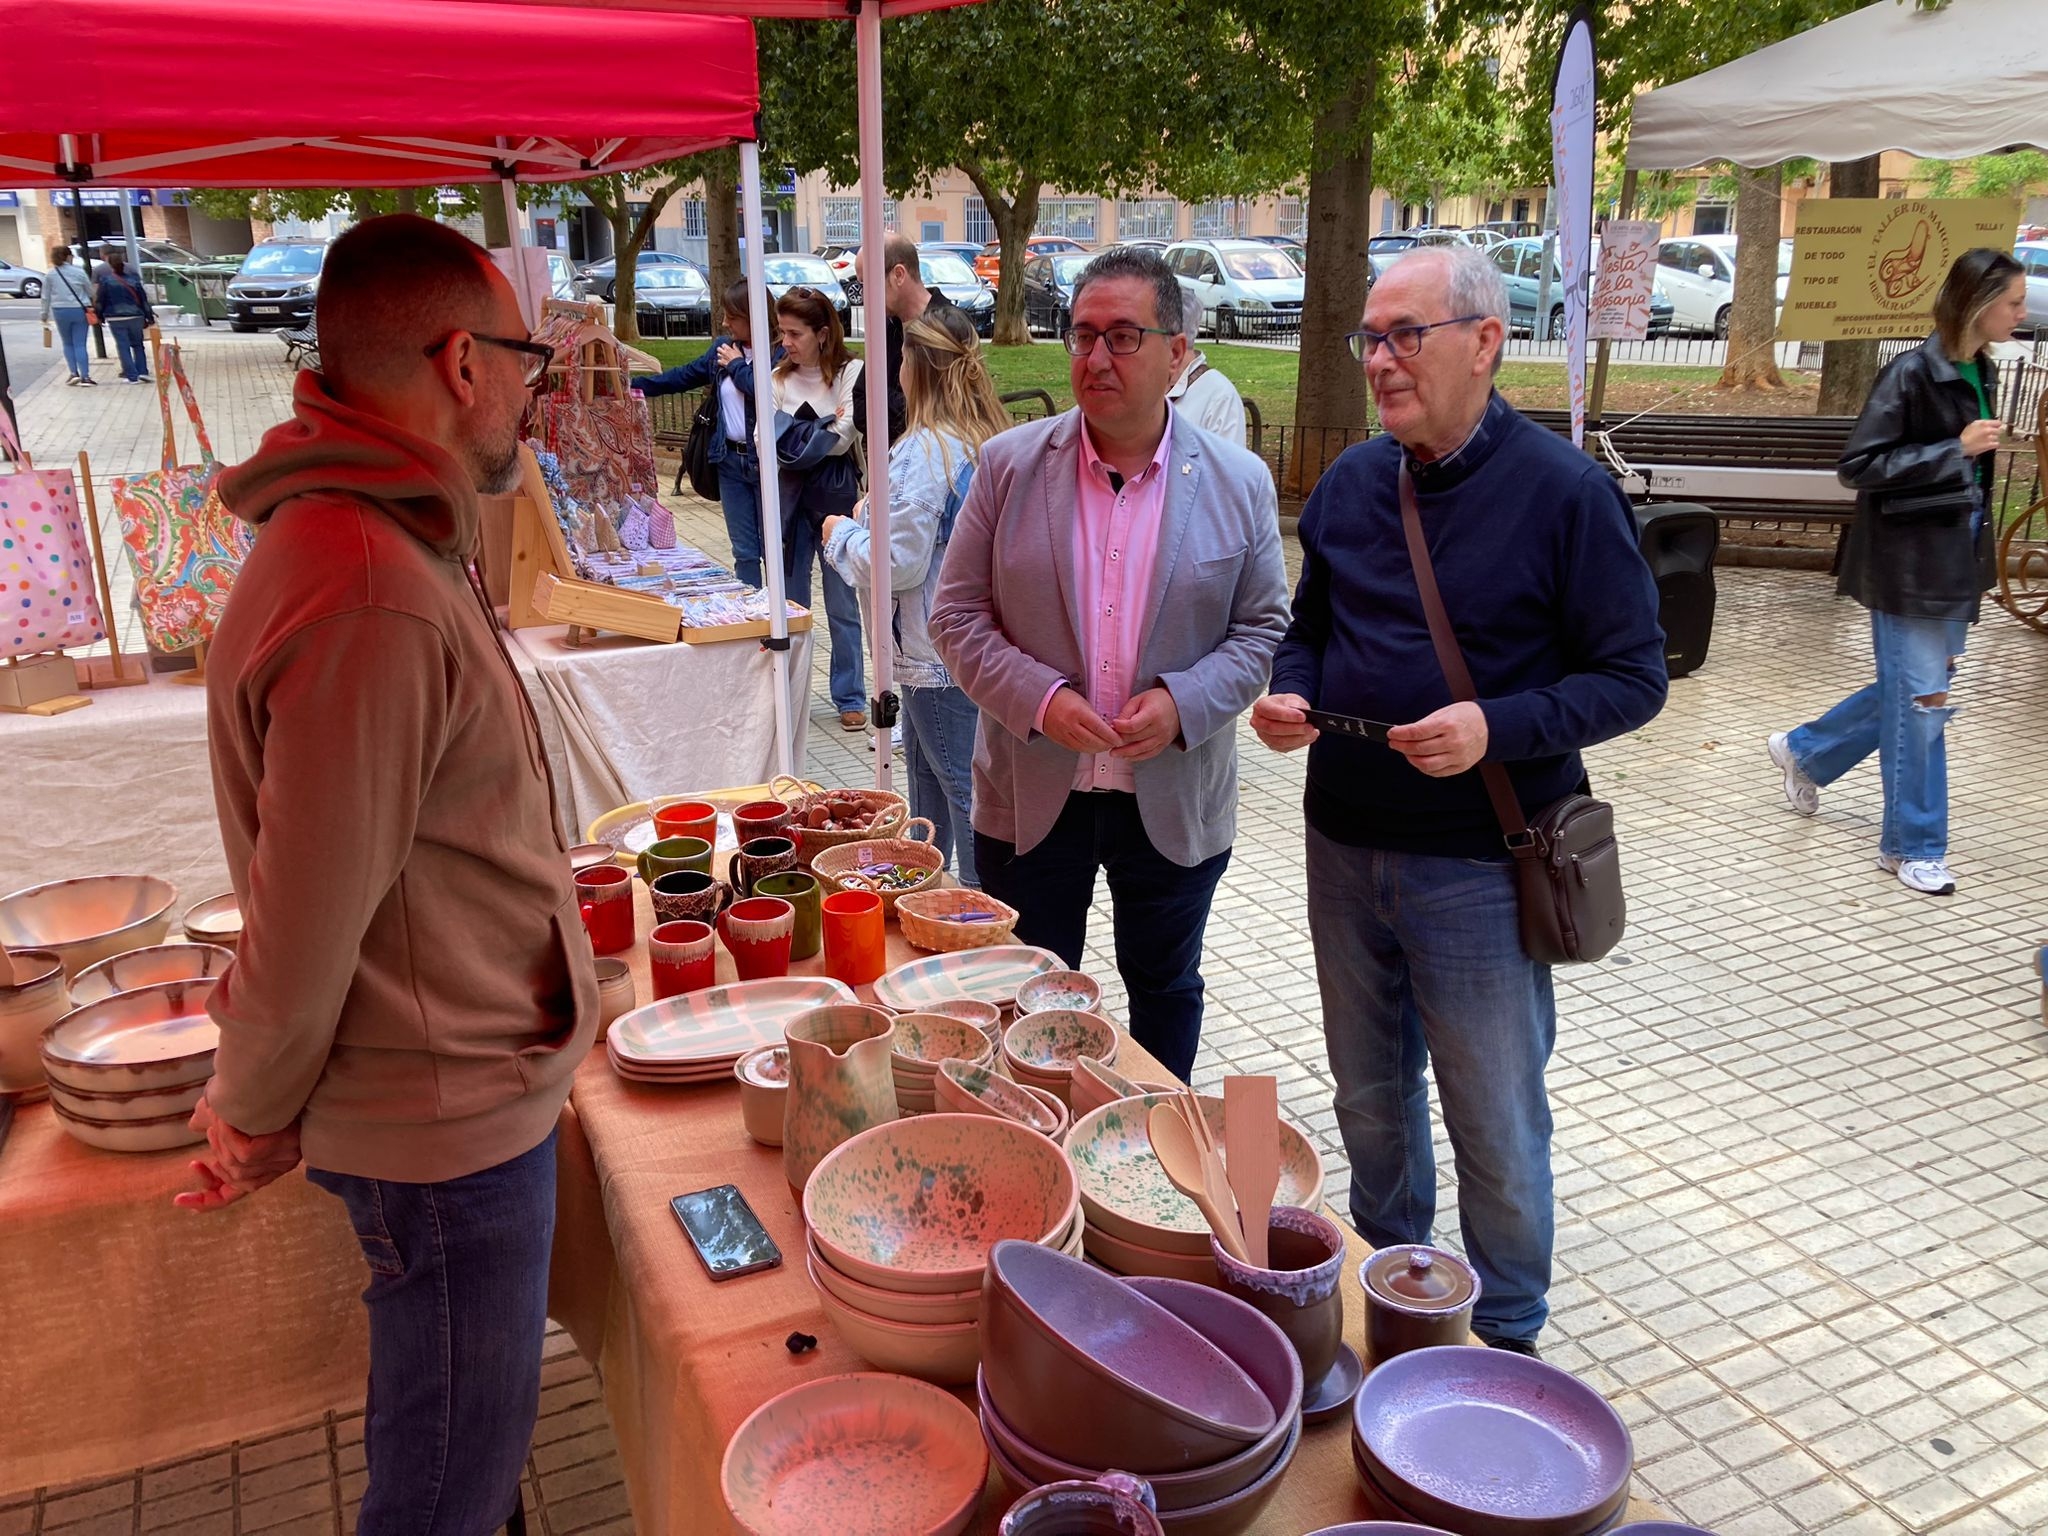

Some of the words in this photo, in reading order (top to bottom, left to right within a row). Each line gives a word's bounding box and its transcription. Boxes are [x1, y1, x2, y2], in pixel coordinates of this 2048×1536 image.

[1975, 222, 1998, 231] TALLA
[1872, 203, 1909, 245] TALLER
[1911, 202, 1928, 215] DE
[1928, 210, 1950, 268] MARCOS
[1804, 251, 1817, 260] DE
[1820, 251, 1846, 260] TODO
[1803, 276, 1825, 285] TIPO
[1827, 276, 1839, 284] DE
[1795, 300, 1837, 310] MUEBLES
